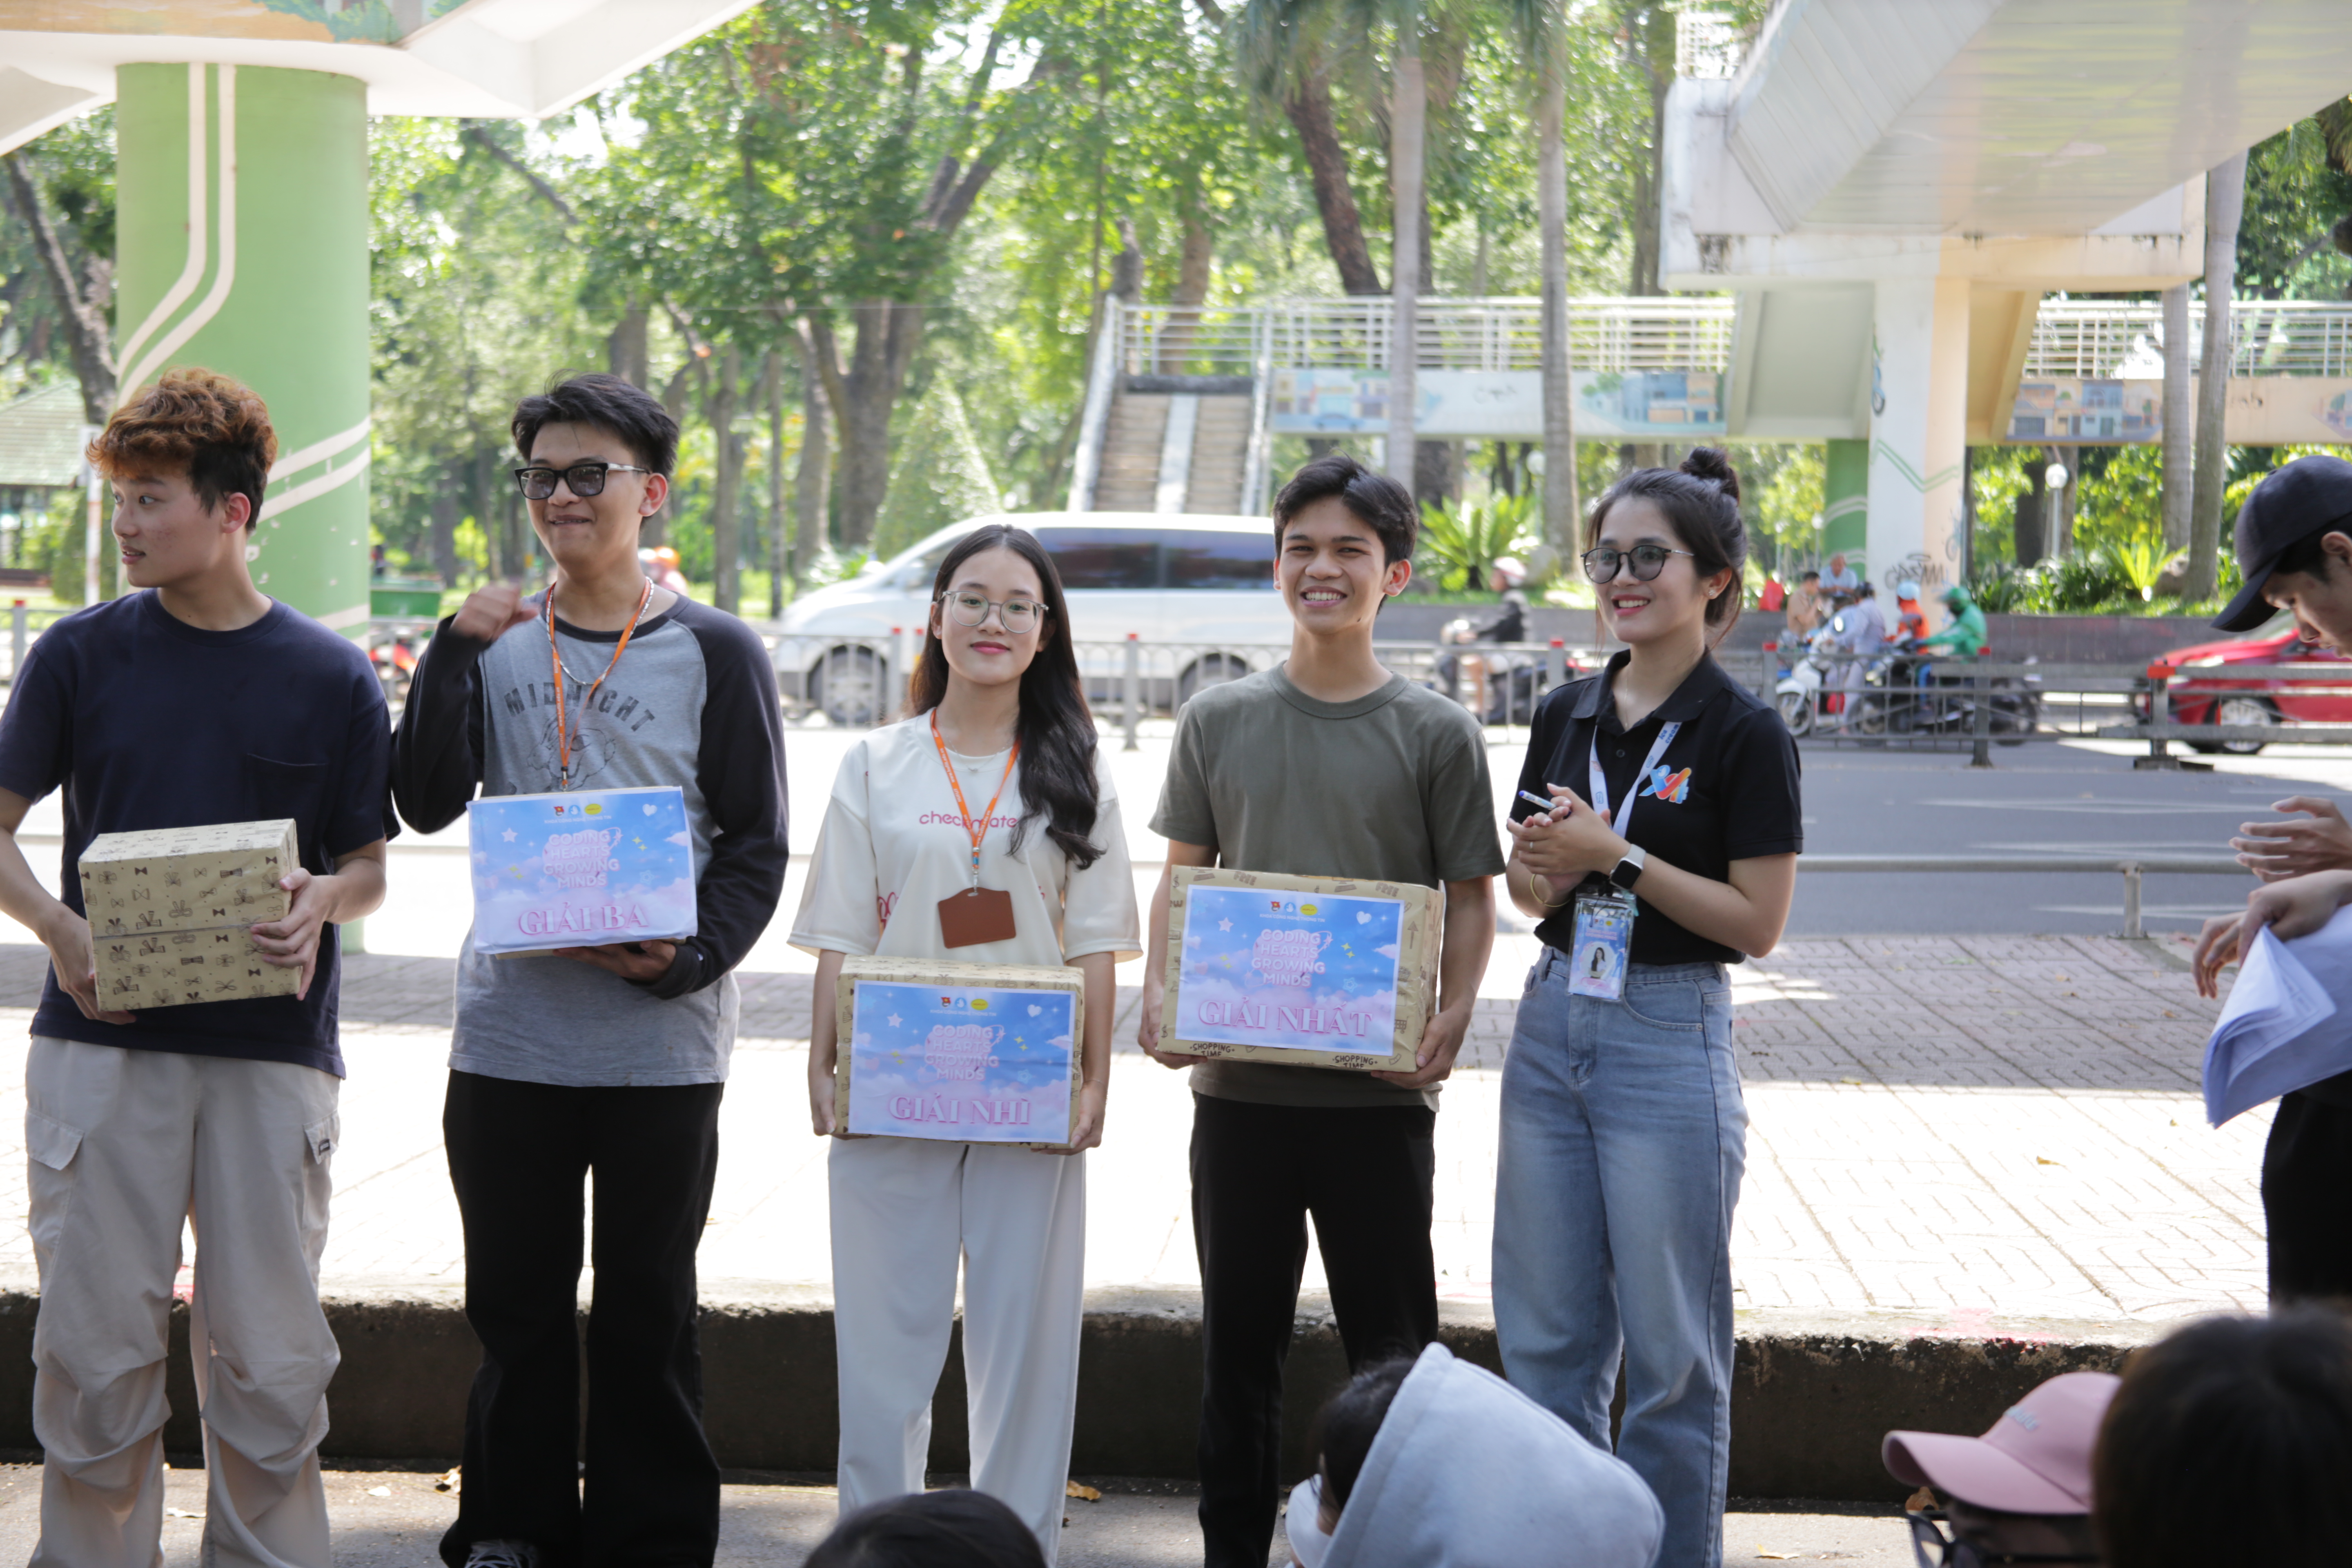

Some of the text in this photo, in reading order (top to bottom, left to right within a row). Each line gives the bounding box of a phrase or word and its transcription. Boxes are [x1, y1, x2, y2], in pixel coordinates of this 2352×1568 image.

[504, 682, 655, 732] MIDNIGHT
[953, 788, 962, 802] HUFLIT
[548, 830, 611, 846] CODING
[551, 845, 610, 860] HEARTS
[543, 859, 619, 875] GROWING
[558, 873, 607, 889] MINDS
[1375, 882, 1399, 897] FREE
[519, 901, 649, 935] GIẢI BA
[1261, 929, 1321, 945] CODING
[1261, 944, 1319, 959] HEARTS
[1252, 958, 1325, 974] GROWING
[1263, 972, 1312, 988] MINDS
[1199, 996, 1373, 1037] GIẢI NHẤT
[933, 1024, 993, 1040] CODING
[933, 1040, 992, 1054] HEARTS
[1193, 1043, 1231, 1053] SHOPPING
[924, 1053, 1000, 1068] GROWING
[1335, 1055, 1374, 1065] SHOPPING
[937, 1067, 985, 1081] MINDS
[889, 1092, 1030, 1124] GIẢI NHÌ
